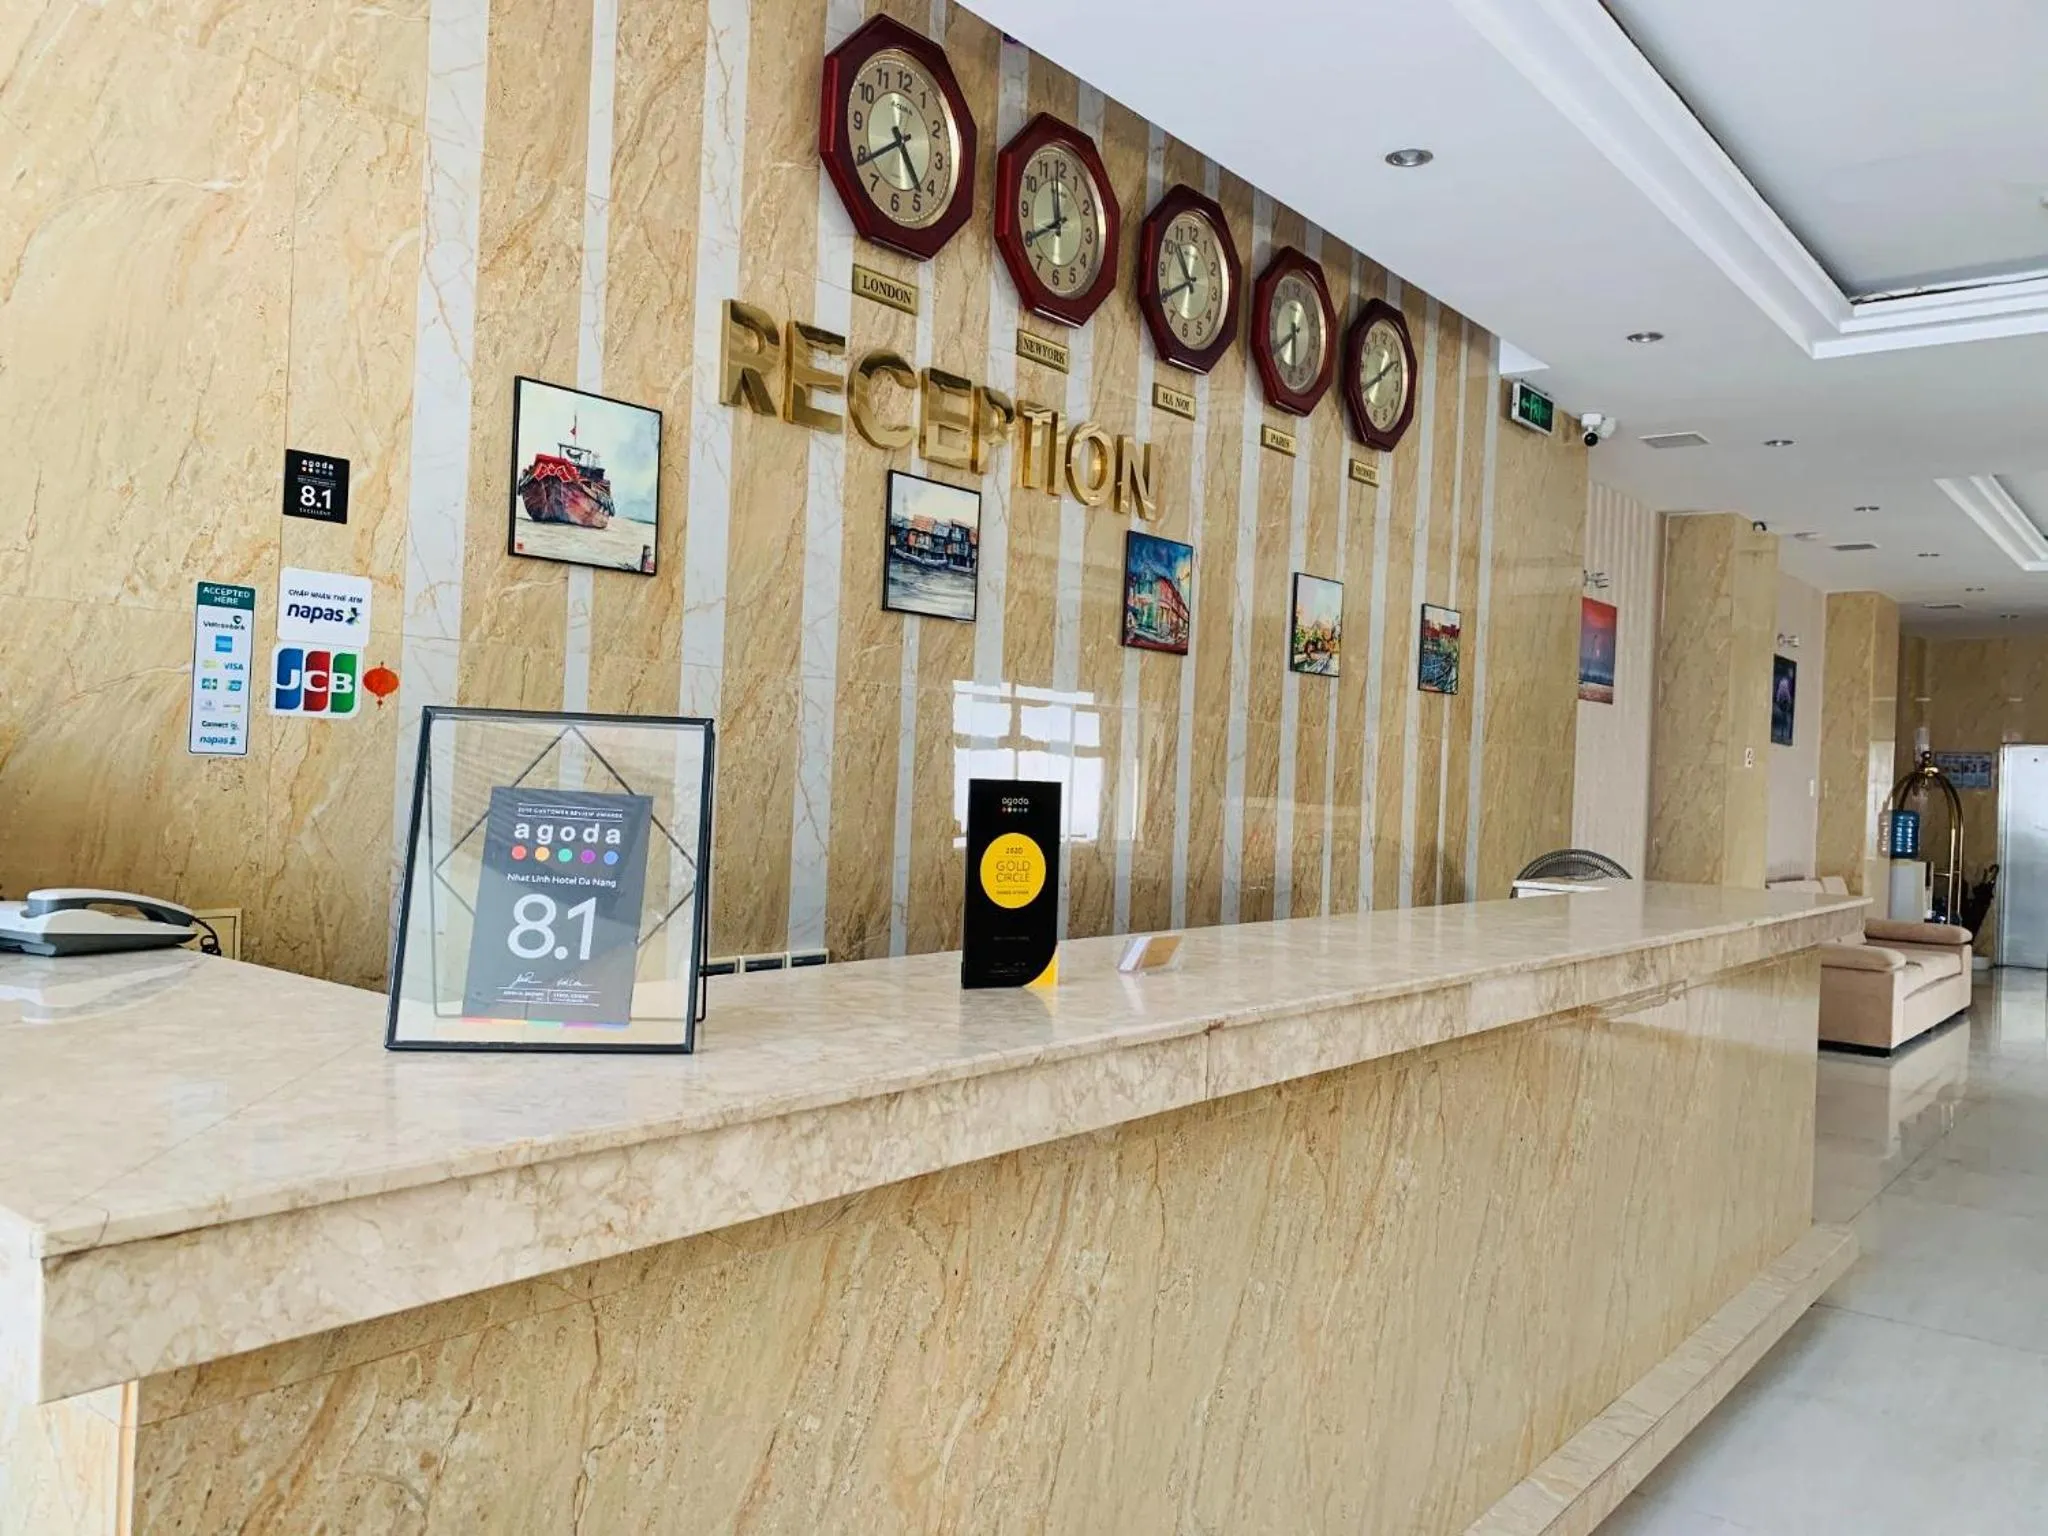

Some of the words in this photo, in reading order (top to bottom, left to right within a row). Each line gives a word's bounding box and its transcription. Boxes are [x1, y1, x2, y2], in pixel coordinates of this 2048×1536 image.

[877, 68, 889, 89] 11
[897, 70, 913, 93] 12
[859, 82, 874, 104] 10
[920, 92, 926, 109] 1
[854, 111, 863, 131] 9
[931, 120, 941, 139] 2
[935, 152, 943, 170] 3
[1038, 160, 1048, 178] 11
[869, 174, 879, 192] 7
[927, 179, 935, 197] 4
[1025, 176, 1037, 193] 10
[1073, 176, 1078, 192] 1
[890, 193, 899, 212] 6
[912, 194, 921, 212] 5
[1021, 201, 1029, 217] 9
[1082, 200, 1089, 216] 2
[1085, 229, 1092, 244] 3
[1174, 225, 1184, 241] 11
[1187, 226, 1199, 243] 12
[1035, 255, 1043, 270] 7
[1080, 253, 1087, 268] 4
[1210, 261, 1217, 276] 2
[1052, 269, 1059, 286] 6
[1069, 268, 1077, 284] 5
[863, 275, 912, 304] LONDON
[719, 299, 1158, 521] RECEPTION
[302, 459, 334, 470] agoda
[300, 485, 332, 510] 8.1
[203, 586, 250, 598] ACCEPTED
[214, 596, 239, 605] HERE
[287, 604, 344, 624] napas
[224, 662, 244, 670] VISA
[276, 669, 353, 693] JCB
[200, 736, 229, 746] napas
[1001, 796, 1029, 806] agoda
[514, 822, 621, 845] agoda
[996, 860, 1031, 872] GOLD
[507, 873, 530, 882] Nhat
[532, 875, 550, 883] Linh
[552, 876, 577, 885] Hotel
[579, 877, 590, 886] Da
[592, 878, 617, 888] Nang
[996, 872, 1031, 883] CIRCLE
[507, 894, 596, 960] 8.1
